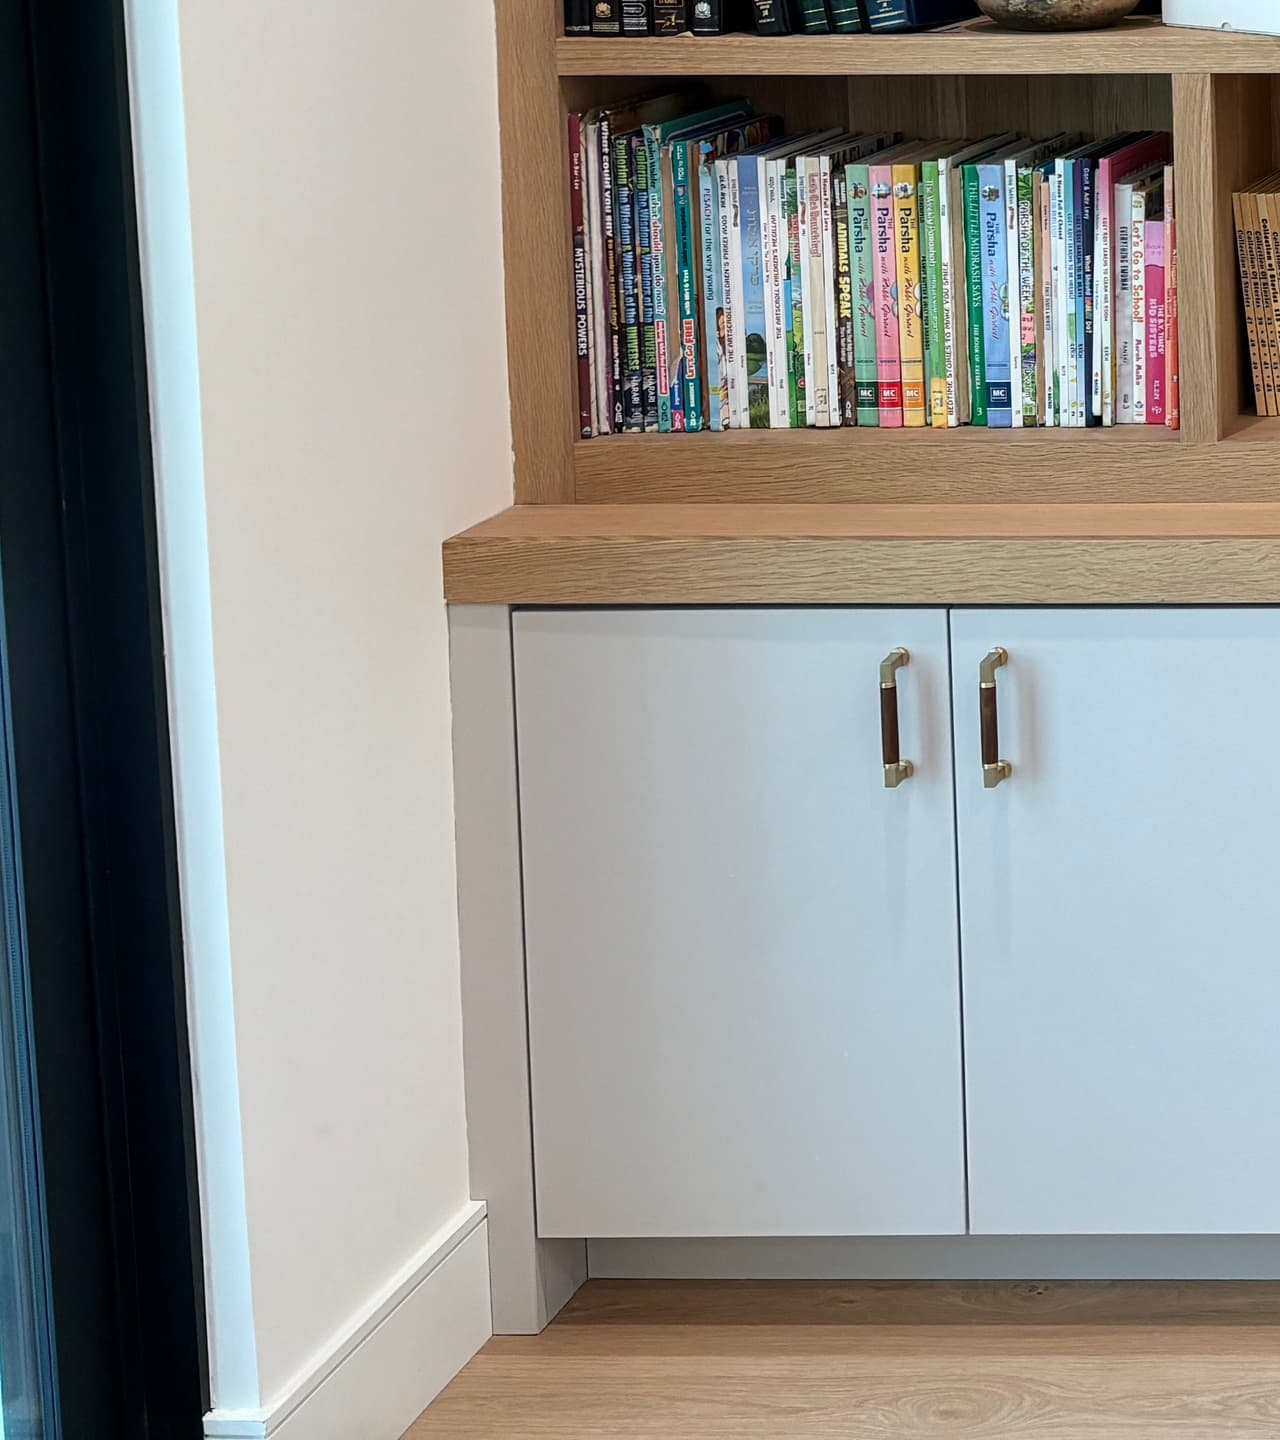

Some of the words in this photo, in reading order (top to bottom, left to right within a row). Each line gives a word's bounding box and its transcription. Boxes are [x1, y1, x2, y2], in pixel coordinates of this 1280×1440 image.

[615, 139, 628, 184] Exploring
[617, 187, 629, 203] the
[704, 188, 712, 221] PESACH
[968, 181, 978, 201] THE
[650, 194, 661, 218] what
[970, 202, 980, 236] LITTLE
[618, 204, 630, 244] Wisdom
[705, 223, 713, 236] for
[853, 207, 864, 254] Parsha
[1020, 201, 1031, 239] PARSHA
[1132, 220, 1144, 247] Let's
[652, 220, 662, 252] should
[706, 238, 714, 252] the
[837, 222, 850, 274] ANIMALS
[985, 212, 997, 257] Parsha
[1021, 241, 1031, 254] OF
[1261, 218, 1274, 261] Collection
[652, 254, 663, 272] you
[704, 253, 714, 273] very
[971, 237, 980, 283] MIDRASH
[1021, 256, 1032, 274] THE
[1133, 250, 1144, 265] Go
[575, 248, 586, 310] MYSTERIOUS
[621, 252, 634, 295] Wonders
[655, 274, 664, 287] do
[705, 274, 715, 300] young
[1133, 269, 1143, 281] to
[654, 288, 666, 314] now?
[972, 285, 981, 307] SAYS
[1022, 276, 1032, 302] WEEK
[1133, 284, 1144, 323] School!
[578, 314, 586, 356] POWERS
[684, 319, 694, 345] FREE
[626, 327, 639, 371] UNIVERSE
[630, 376, 641, 404] HARARI
